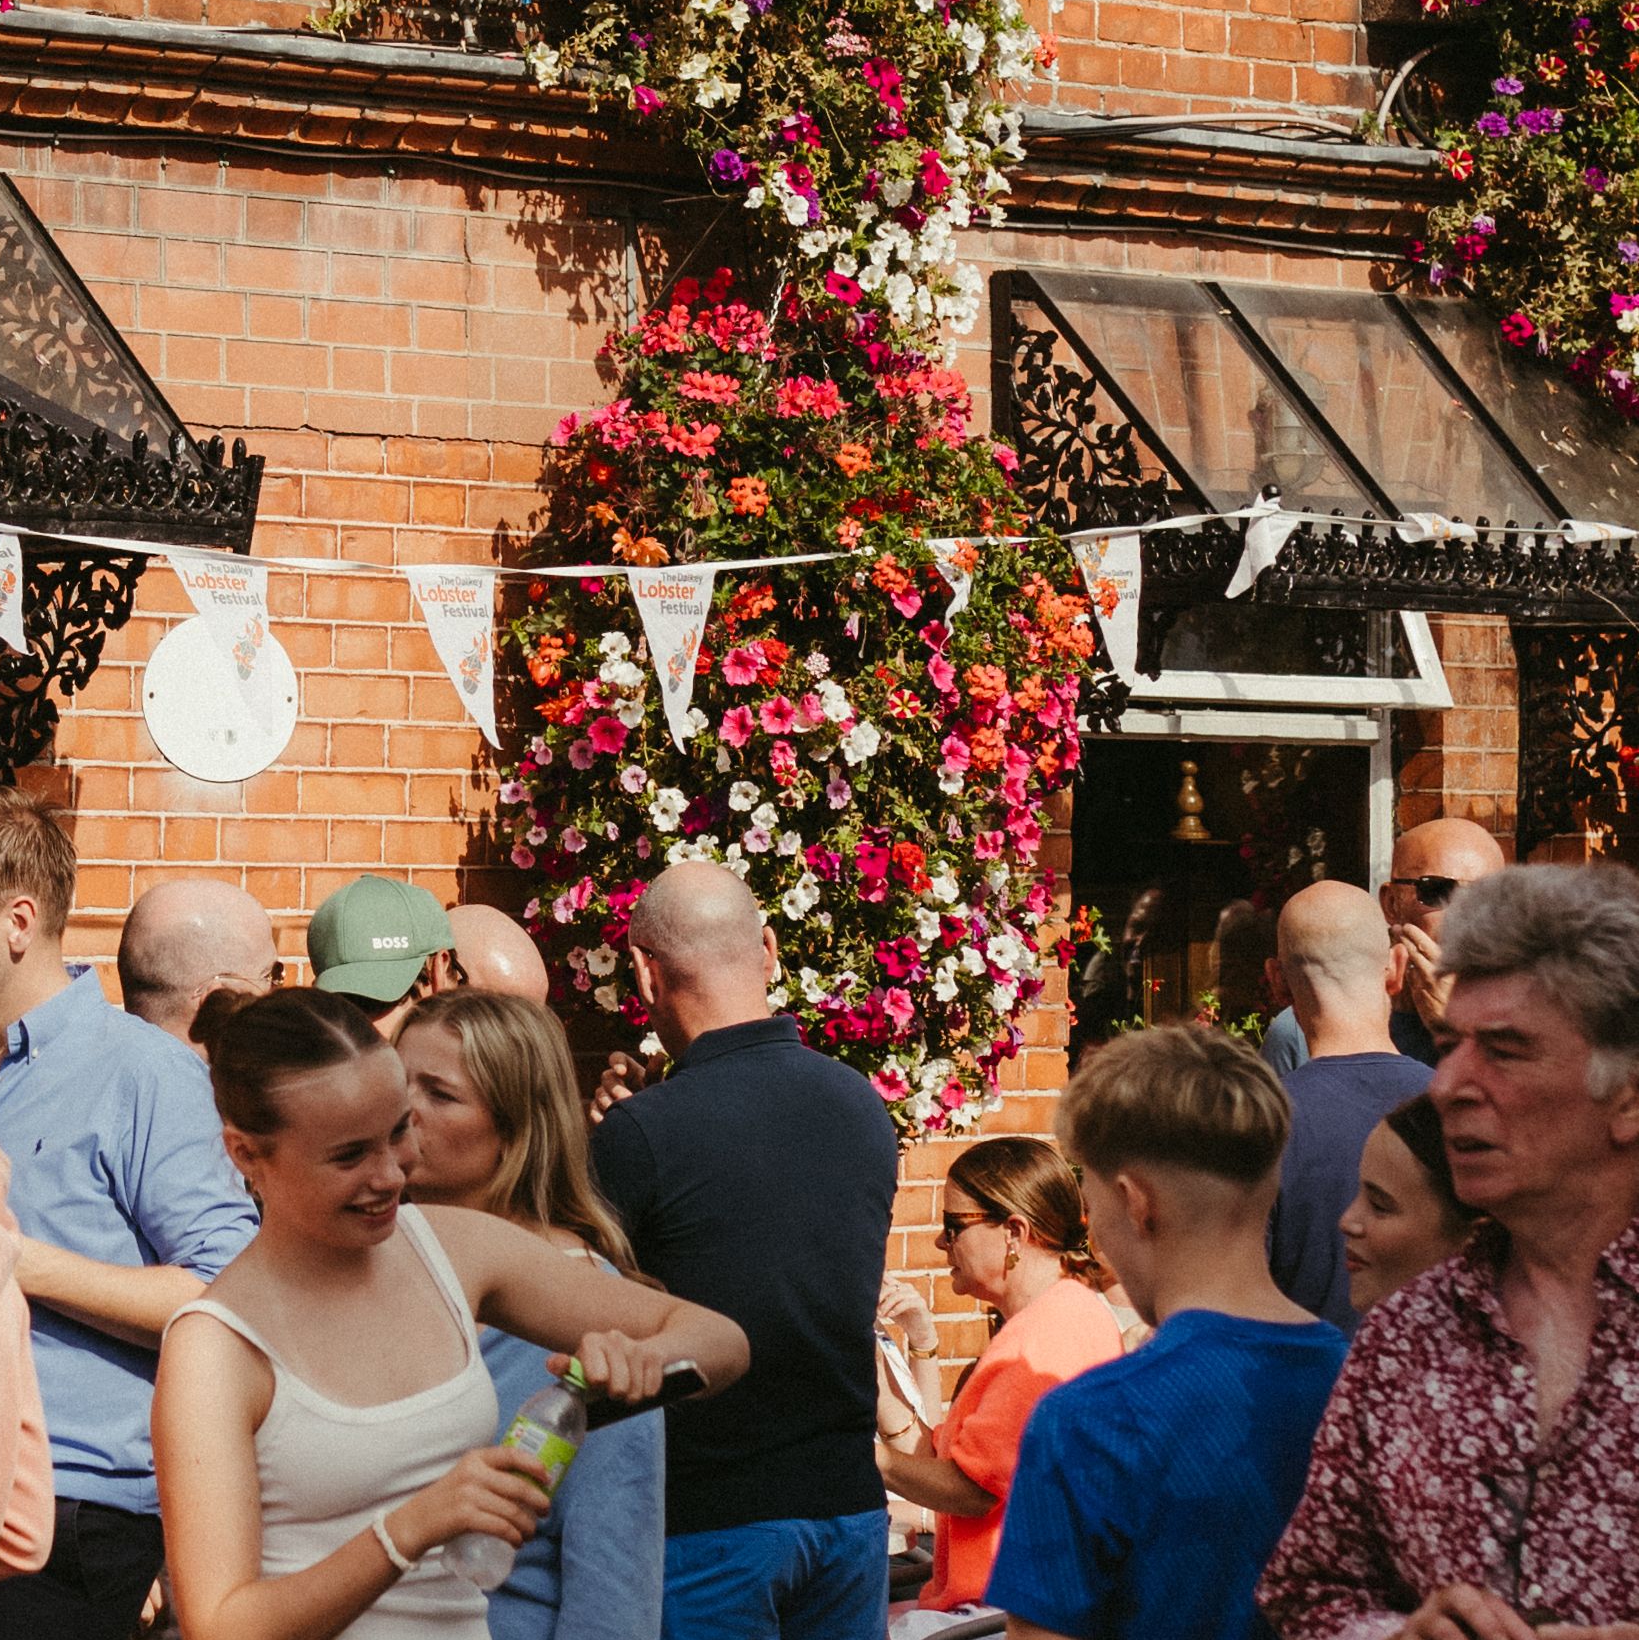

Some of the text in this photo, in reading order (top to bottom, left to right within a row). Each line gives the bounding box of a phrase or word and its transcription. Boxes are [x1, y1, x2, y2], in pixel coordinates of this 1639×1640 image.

[204, 563, 254, 577] The Dalkey
[661, 572, 677, 582] The
[183, 569, 248, 591] Lobster
[439, 575, 455, 586] The
[417, 583, 477, 602] Lobster
[637, 580, 696, 600] Lobster
[210, 591, 262, 606] Festival
[441, 604, 490, 618] Festival
[660, 600, 703, 616] Festival
[372, 936, 409, 949] BOSS
